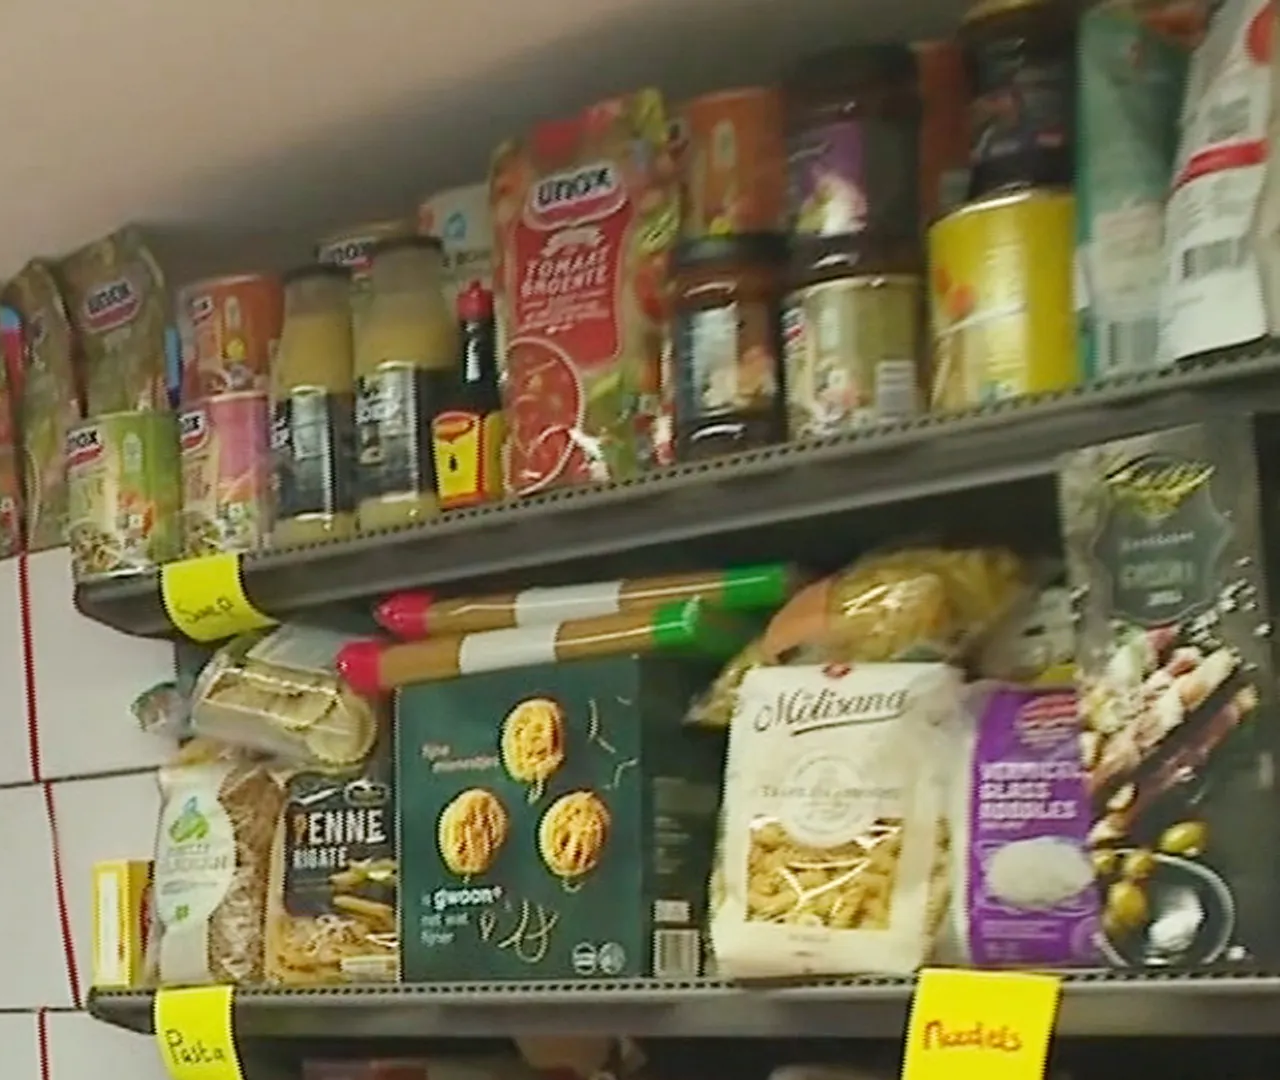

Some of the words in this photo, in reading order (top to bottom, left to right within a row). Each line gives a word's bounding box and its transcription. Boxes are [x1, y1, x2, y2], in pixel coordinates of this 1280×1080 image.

[526, 245, 613, 277] TOMAAT
[293, 809, 387, 845] PENNE
[166, 1028, 226, 1065] Pasta
